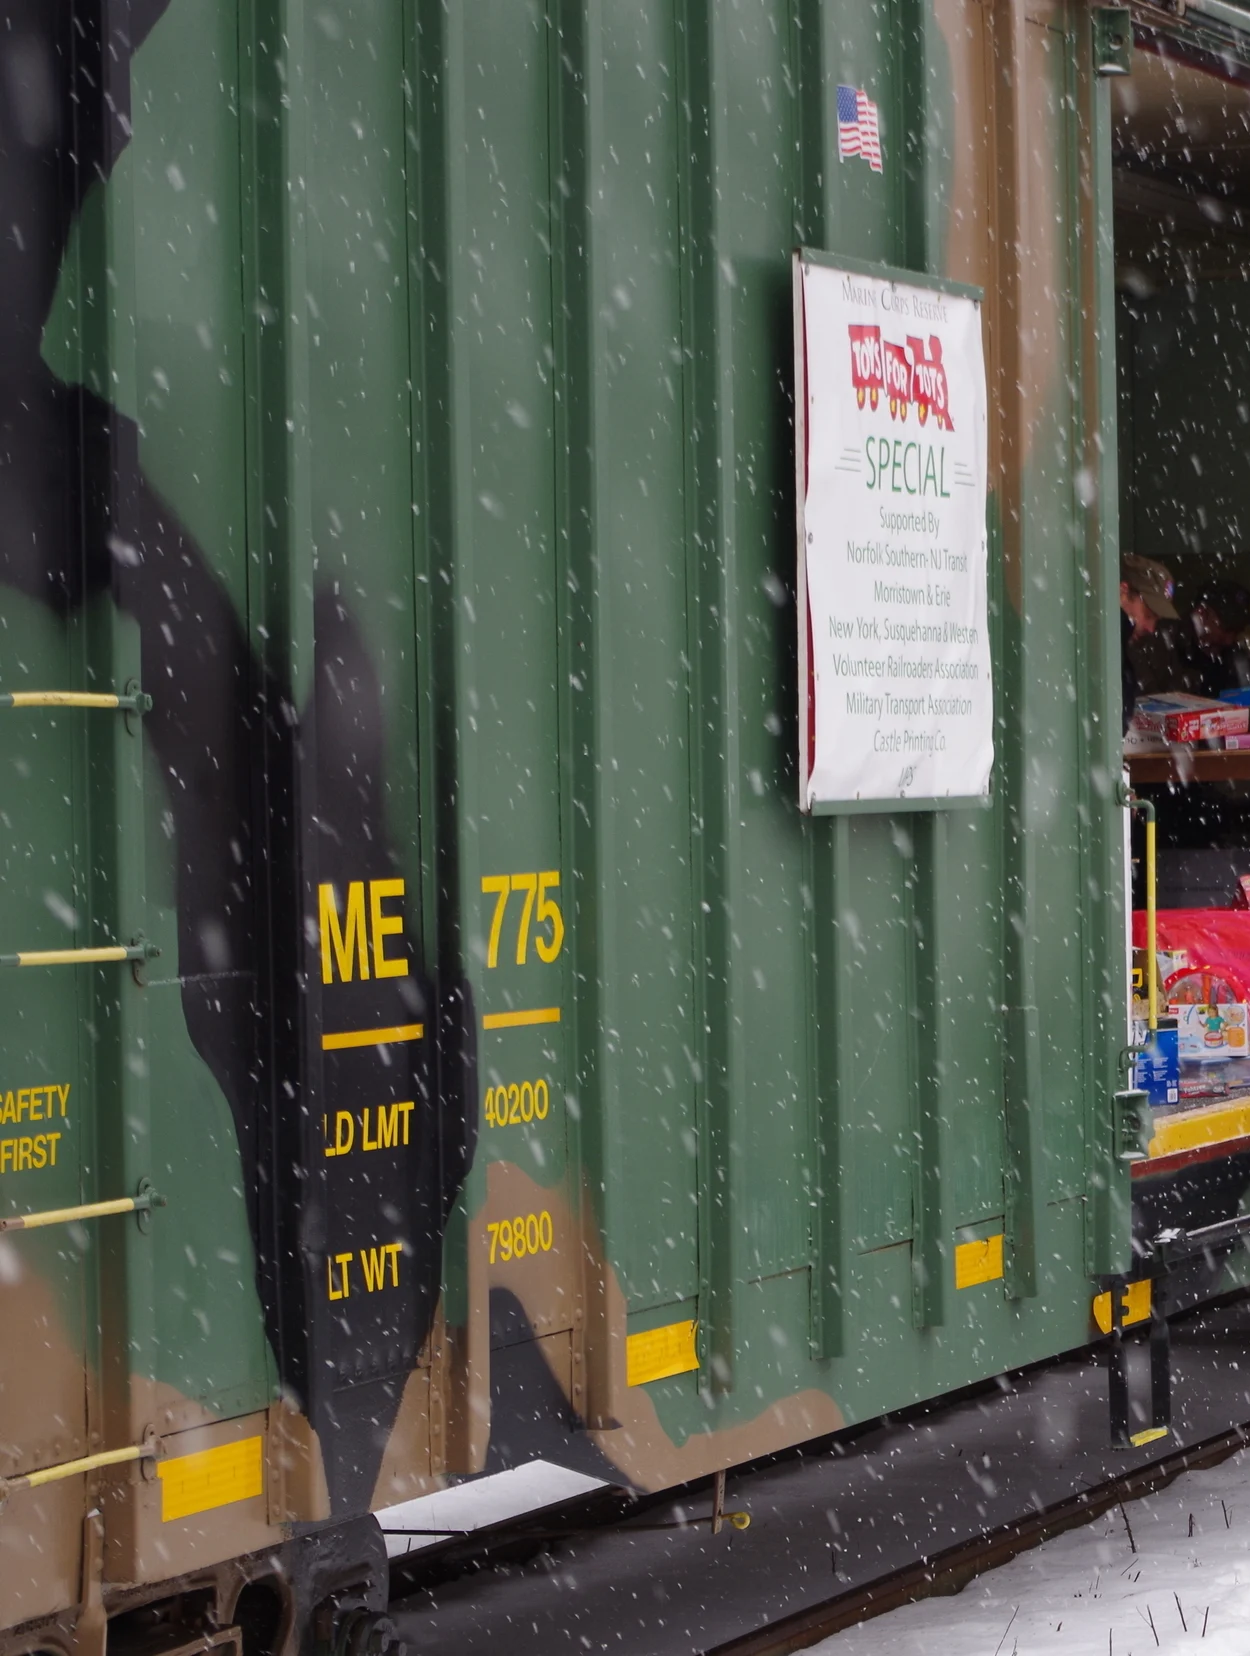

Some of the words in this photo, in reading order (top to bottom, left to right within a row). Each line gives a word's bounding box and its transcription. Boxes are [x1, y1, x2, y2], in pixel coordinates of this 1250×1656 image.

[881, 287, 909, 316] CORPS
[913, 295, 949, 324] RESERVE
[852, 336, 882, 380] TOYS
[886, 351, 907, 396] FOR
[916, 363, 945, 410] TOTS
[866, 435, 951, 498] SPECIAL
[880, 506, 927, 536] Supported
[928, 511, 940, 539] By
[847, 541, 884, 566] Norfolk
[930, 546, 942, 572] NJ
[943, 548, 968, 574] Transit
[874, 580, 926, 606] Morristown
[927, 584, 934, 606] &
[935, 584, 951, 607] Erie
[829, 615, 854, 640] New
[856, 616, 882, 643] York,
[884, 618, 942, 646] Susquehanna
[943, 621, 949, 643] &
[833, 654, 886, 678] Volunteer
[887, 655, 933, 680] Railroaders
[934, 657, 979, 681] Association
[846, 692, 884, 721] Military
[884, 693, 926, 720] Transport
[928, 694, 972, 717] Association
[873, 729, 901, 752] Castle
[903, 729, 934, 757] Printing
[319, 878, 409, 984] ME
[482, 871, 564, 968] 775
[0, 1083, 70, 1125] AFETY
[485, 1078, 549, 1128] 40200
[362, 1101, 415, 1152] LMT
[0, 1132, 61, 1174] FIRST
[487, 1210, 553, 1265] 79800
[328, 1252, 353, 1301] LT
[360, 1243, 403, 1293] WT
